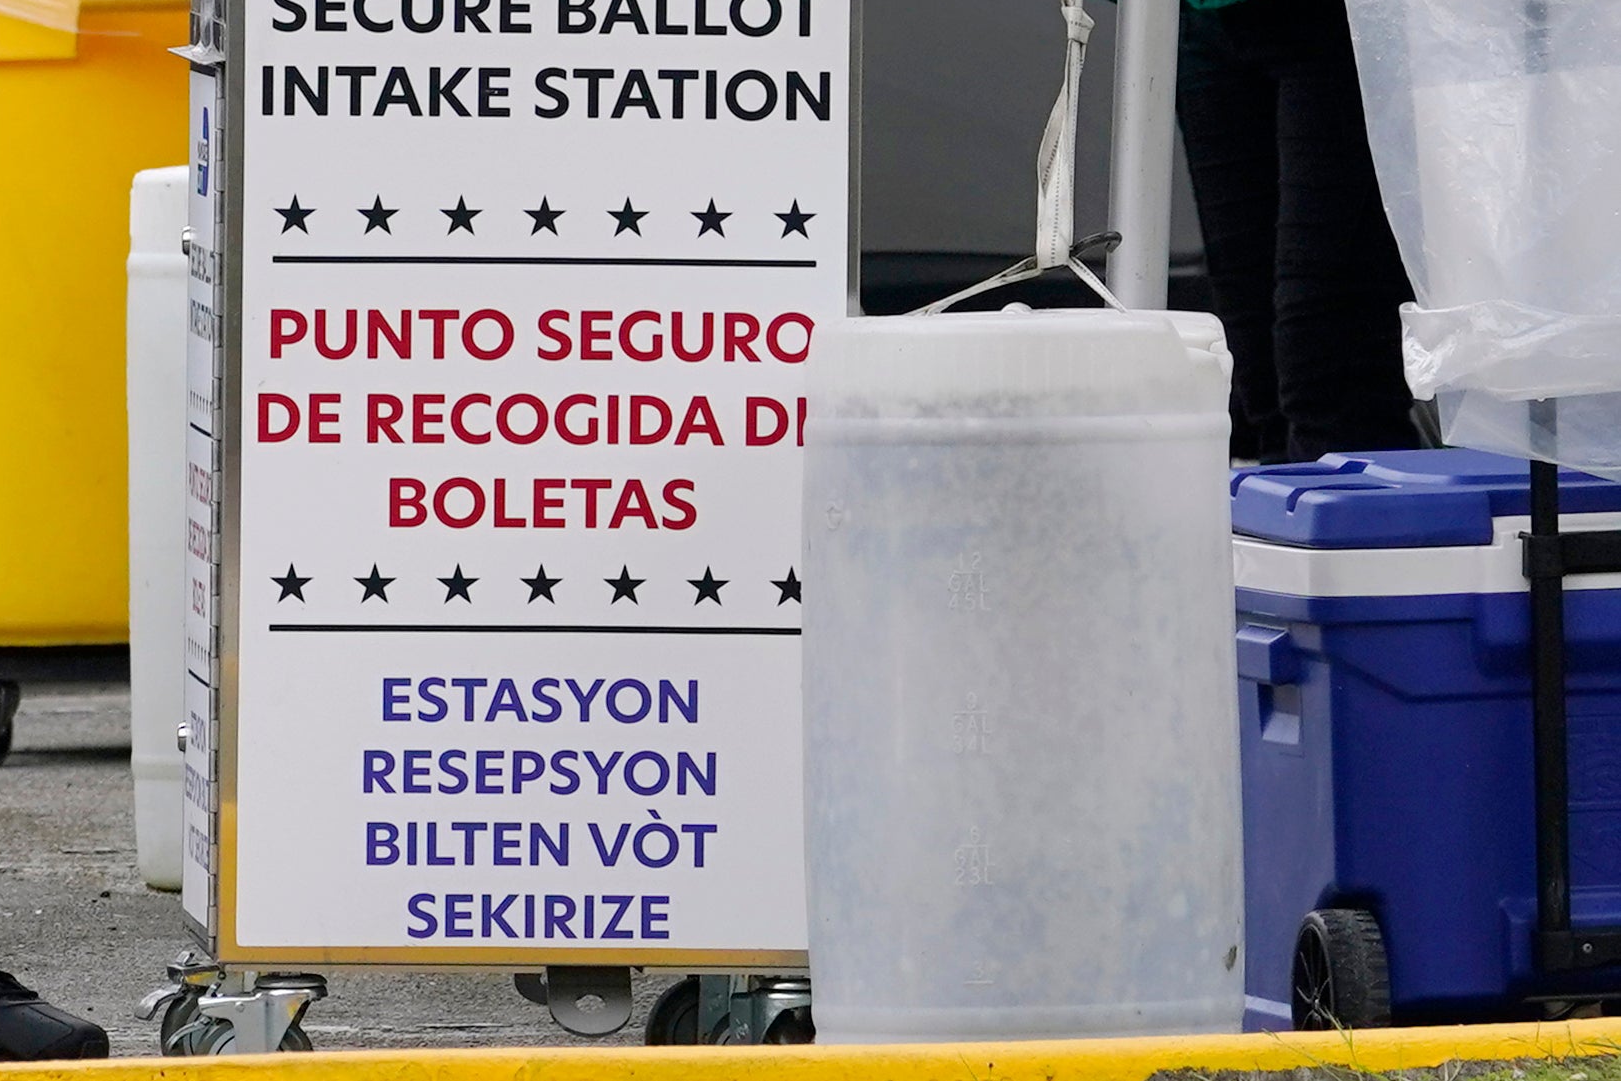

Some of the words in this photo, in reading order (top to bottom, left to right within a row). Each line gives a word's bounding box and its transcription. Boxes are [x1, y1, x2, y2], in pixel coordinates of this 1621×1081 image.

[261, 65, 512, 118] INTAKE
[534, 66, 832, 122] STATION
[269, 308, 515, 362] PUNTO
[537, 308, 816, 364] SEGURO
[257, 392, 342, 444] DE
[366, 392, 726, 447] RECOGIDA
[388, 476, 698, 531] BOLETAS
[382, 676, 699, 725] ESTASYON
[362, 748, 717, 797] RESEPSYON
[365, 821, 570, 867] BILTEN
[586, 808, 718, 869] VÒT
[407, 892, 670, 940] SEKIRIZE
